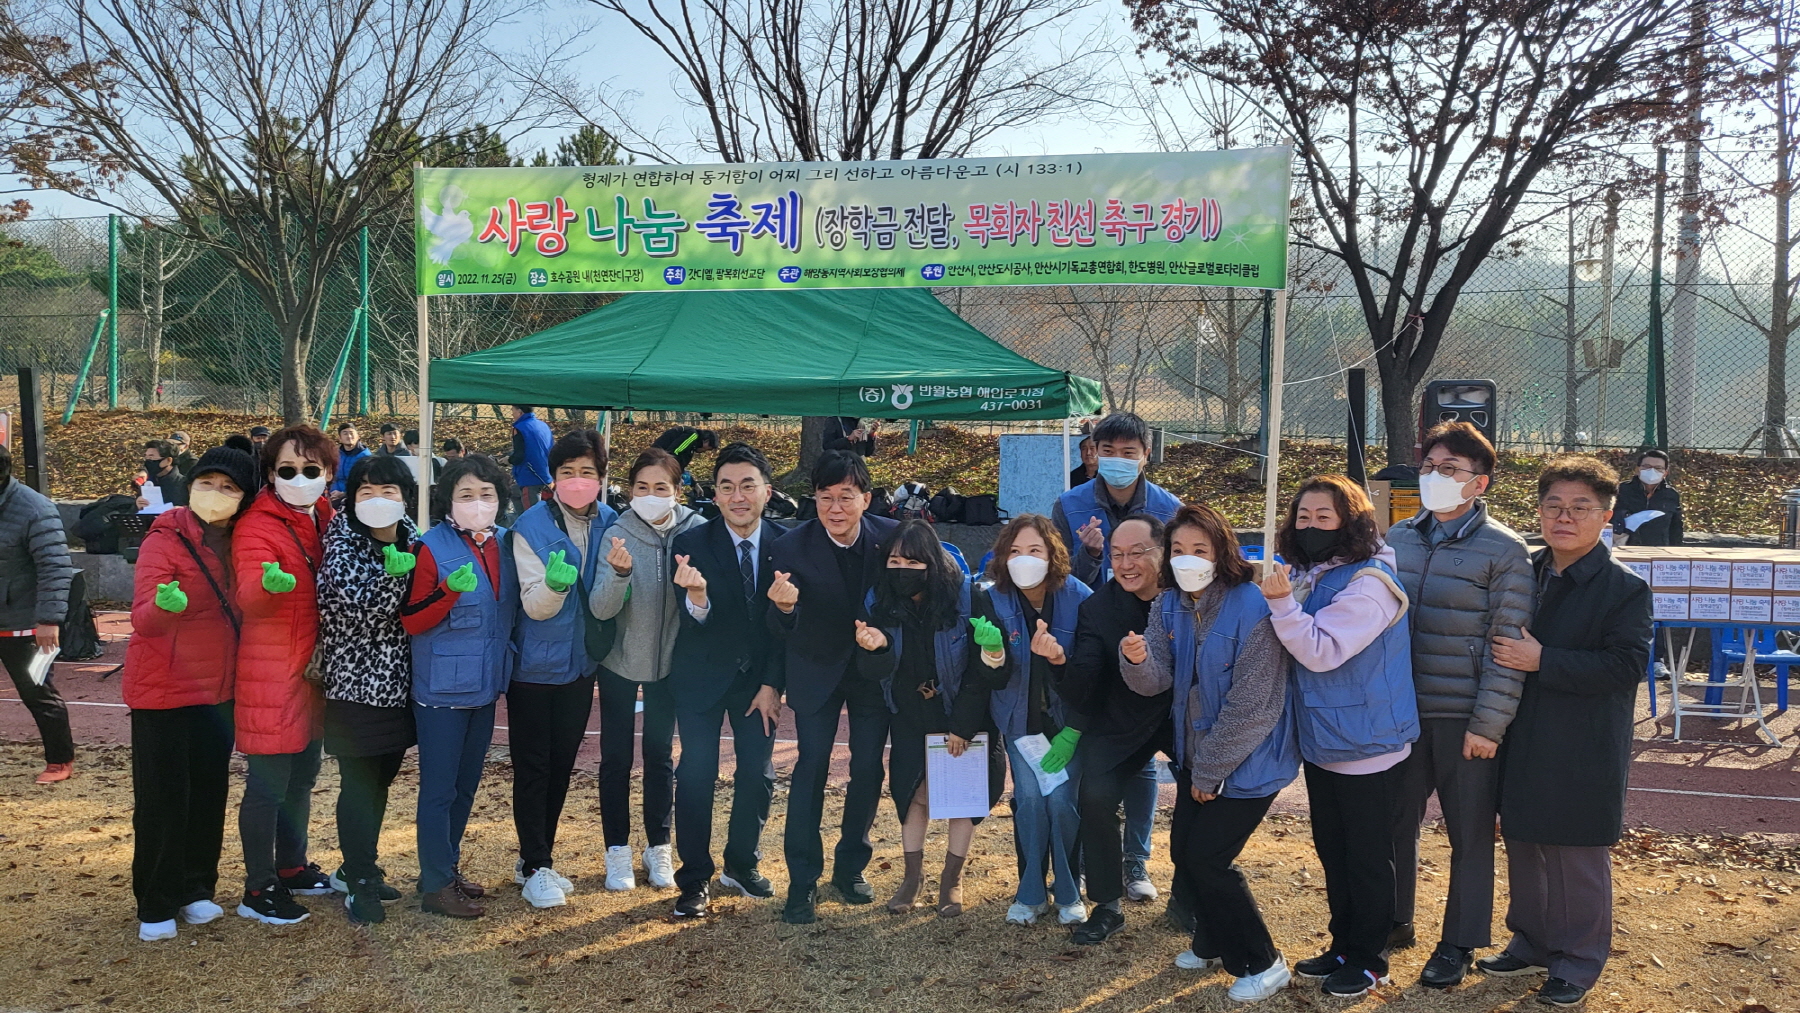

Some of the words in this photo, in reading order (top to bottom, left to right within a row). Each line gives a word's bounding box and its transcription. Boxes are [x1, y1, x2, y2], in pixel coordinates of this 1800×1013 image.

[582, 171, 628, 189] 형제가
[633, 170, 694, 187] 연합하여
[699, 169, 763, 185] 동거함이
[769, 168, 800, 183] 어찌
[805, 167, 838, 182] 그리
[844, 166, 894, 182] 선하고
[901, 165, 989, 180] 아름다운고
[996, 162, 1019, 178] (시
[1028, 161, 1082, 177] 133:1)
[478, 195, 578, 258] 사랑
[586, 194, 689, 257] 나눔
[695, 190, 804, 255] 축제
[814, 203, 899, 251] (장학금
[902, 202, 959, 250] 전달,
[962, 199, 1043, 248] 목회자
[1047, 198, 1096, 248] 친선
[1100, 198, 1157, 246] 축구
[1160, 197, 1221, 244] 경기)
[550, 270, 580, 284] 호수공원
[665, 268, 683, 282] 주최
[780, 268, 799, 280] 주관
[923, 265, 943, 278] 후원
[948, 264, 976, 278] 안산시,
[977, 262, 1033, 277] 안산도시공사,
[1169, 261, 1260, 279] 안산글로벌로타리클럽
[437, 273, 455, 287] 일시
[529, 271, 547, 285] 장소
[859, 387, 886, 403] (증)
[918, 384, 973, 398] 반월농협
[976, 386, 1046, 399] 해안로지점
[980, 400, 1042, 412] 437-0031
